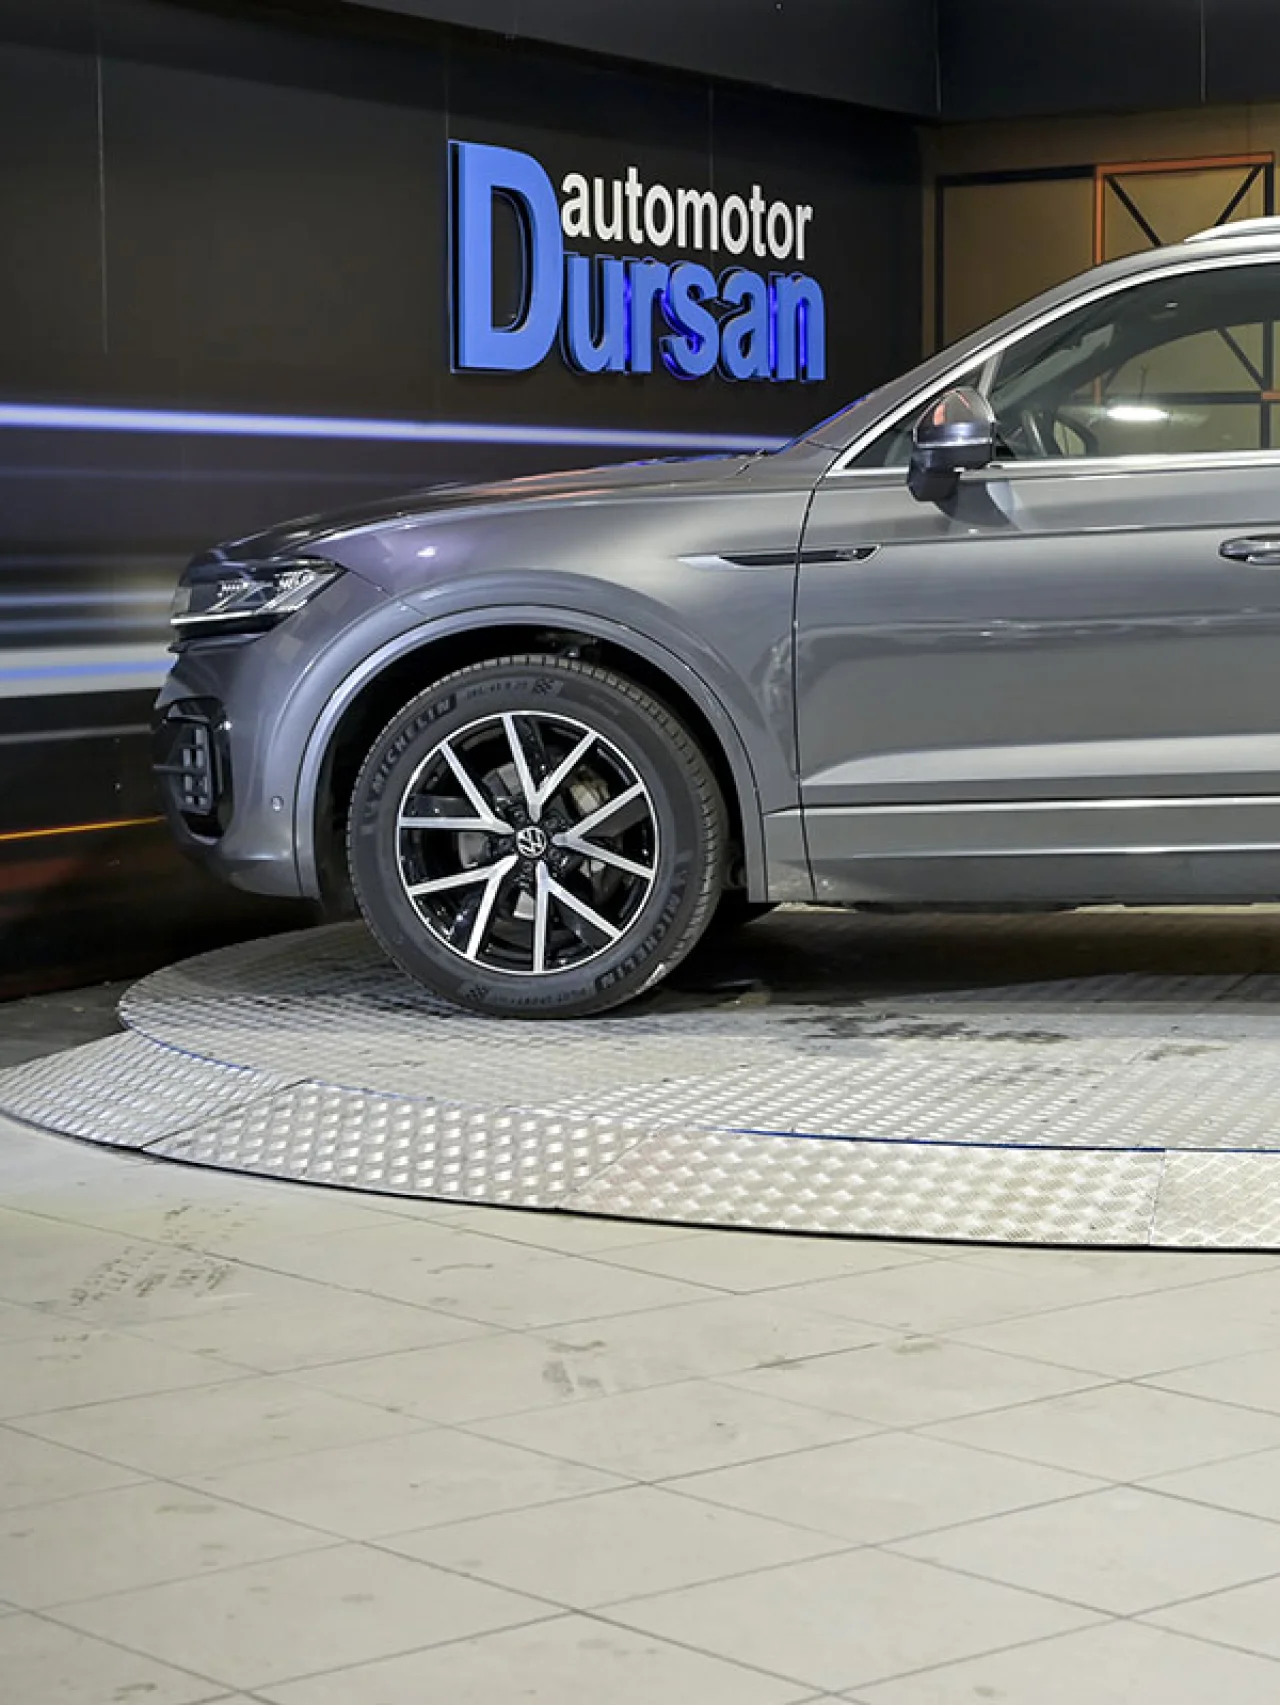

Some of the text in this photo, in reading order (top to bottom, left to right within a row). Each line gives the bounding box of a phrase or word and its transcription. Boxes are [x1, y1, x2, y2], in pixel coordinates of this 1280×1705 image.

[448, 138, 826, 382] Dursan
[561, 165, 814, 261] automotor
[367, 694, 453, 794] MICHELIN
